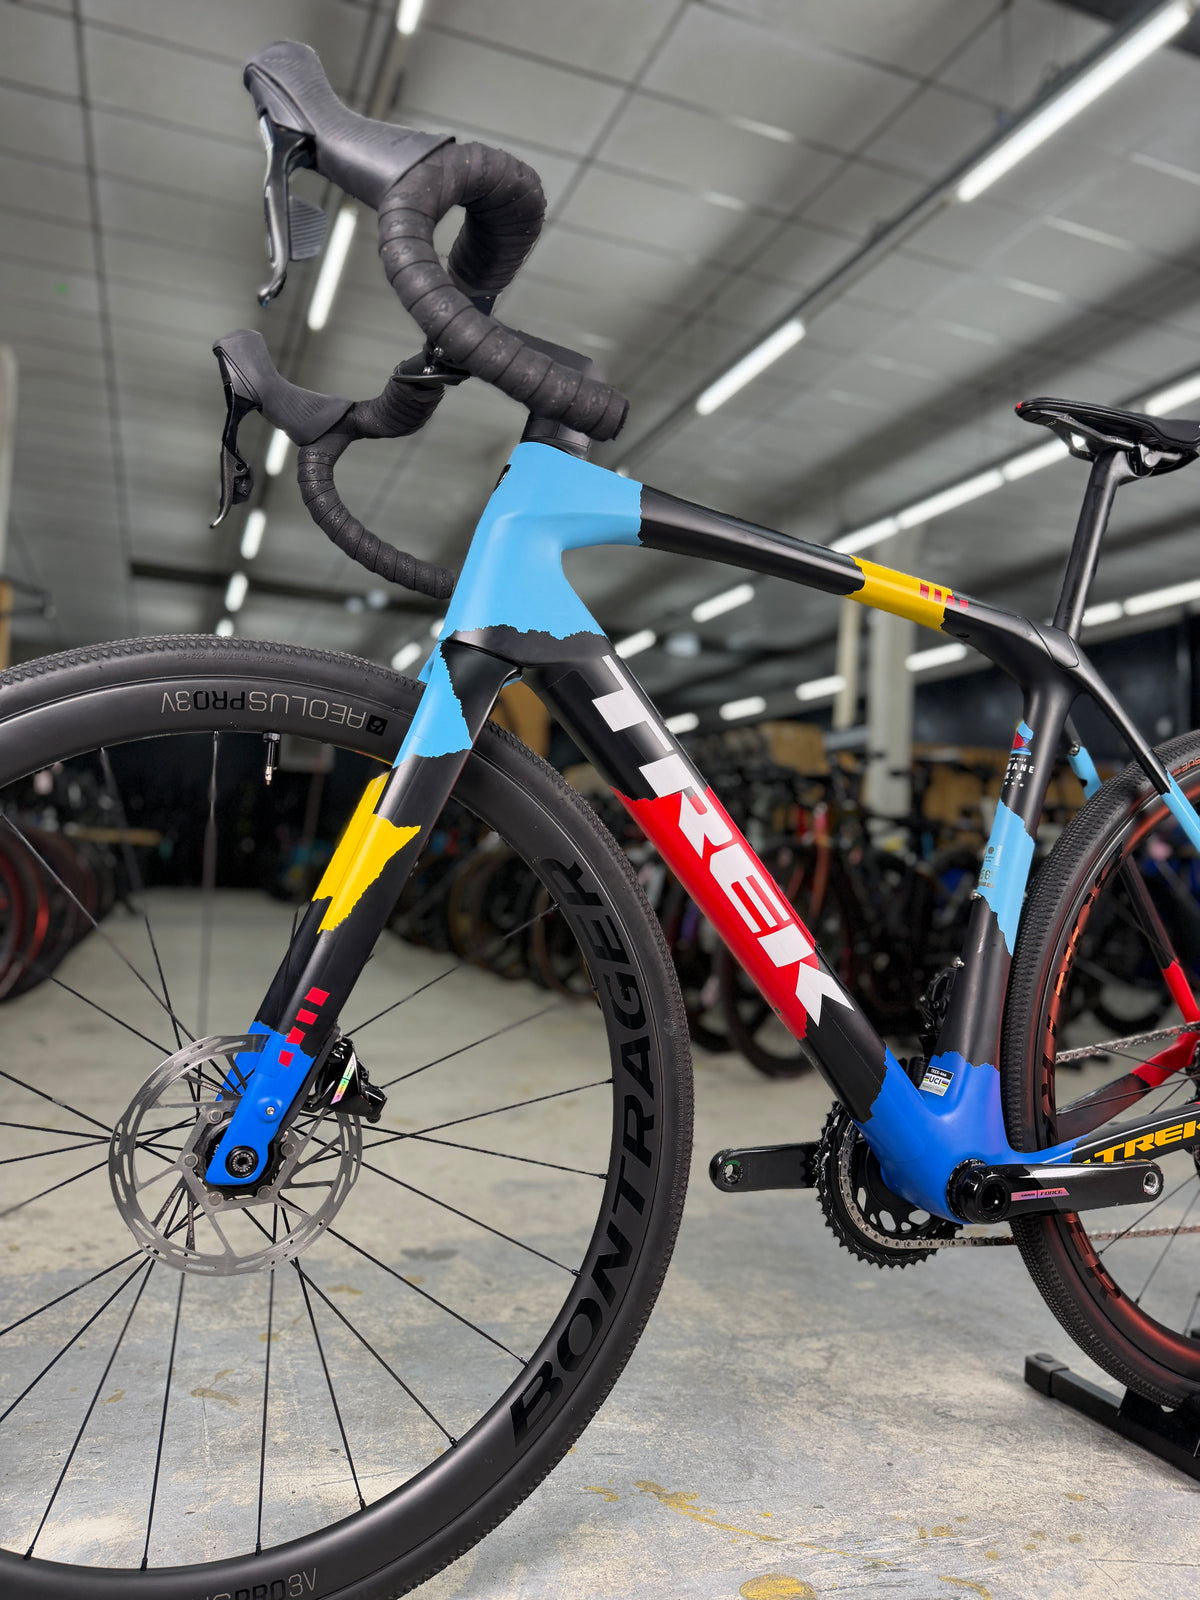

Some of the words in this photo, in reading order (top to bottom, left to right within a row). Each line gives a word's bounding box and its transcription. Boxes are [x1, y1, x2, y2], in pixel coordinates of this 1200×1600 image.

[592, 654, 855, 1027] TREK
[510, 857, 655, 1449] BONTRAGER
[929, 1075, 942, 1086] UCI
